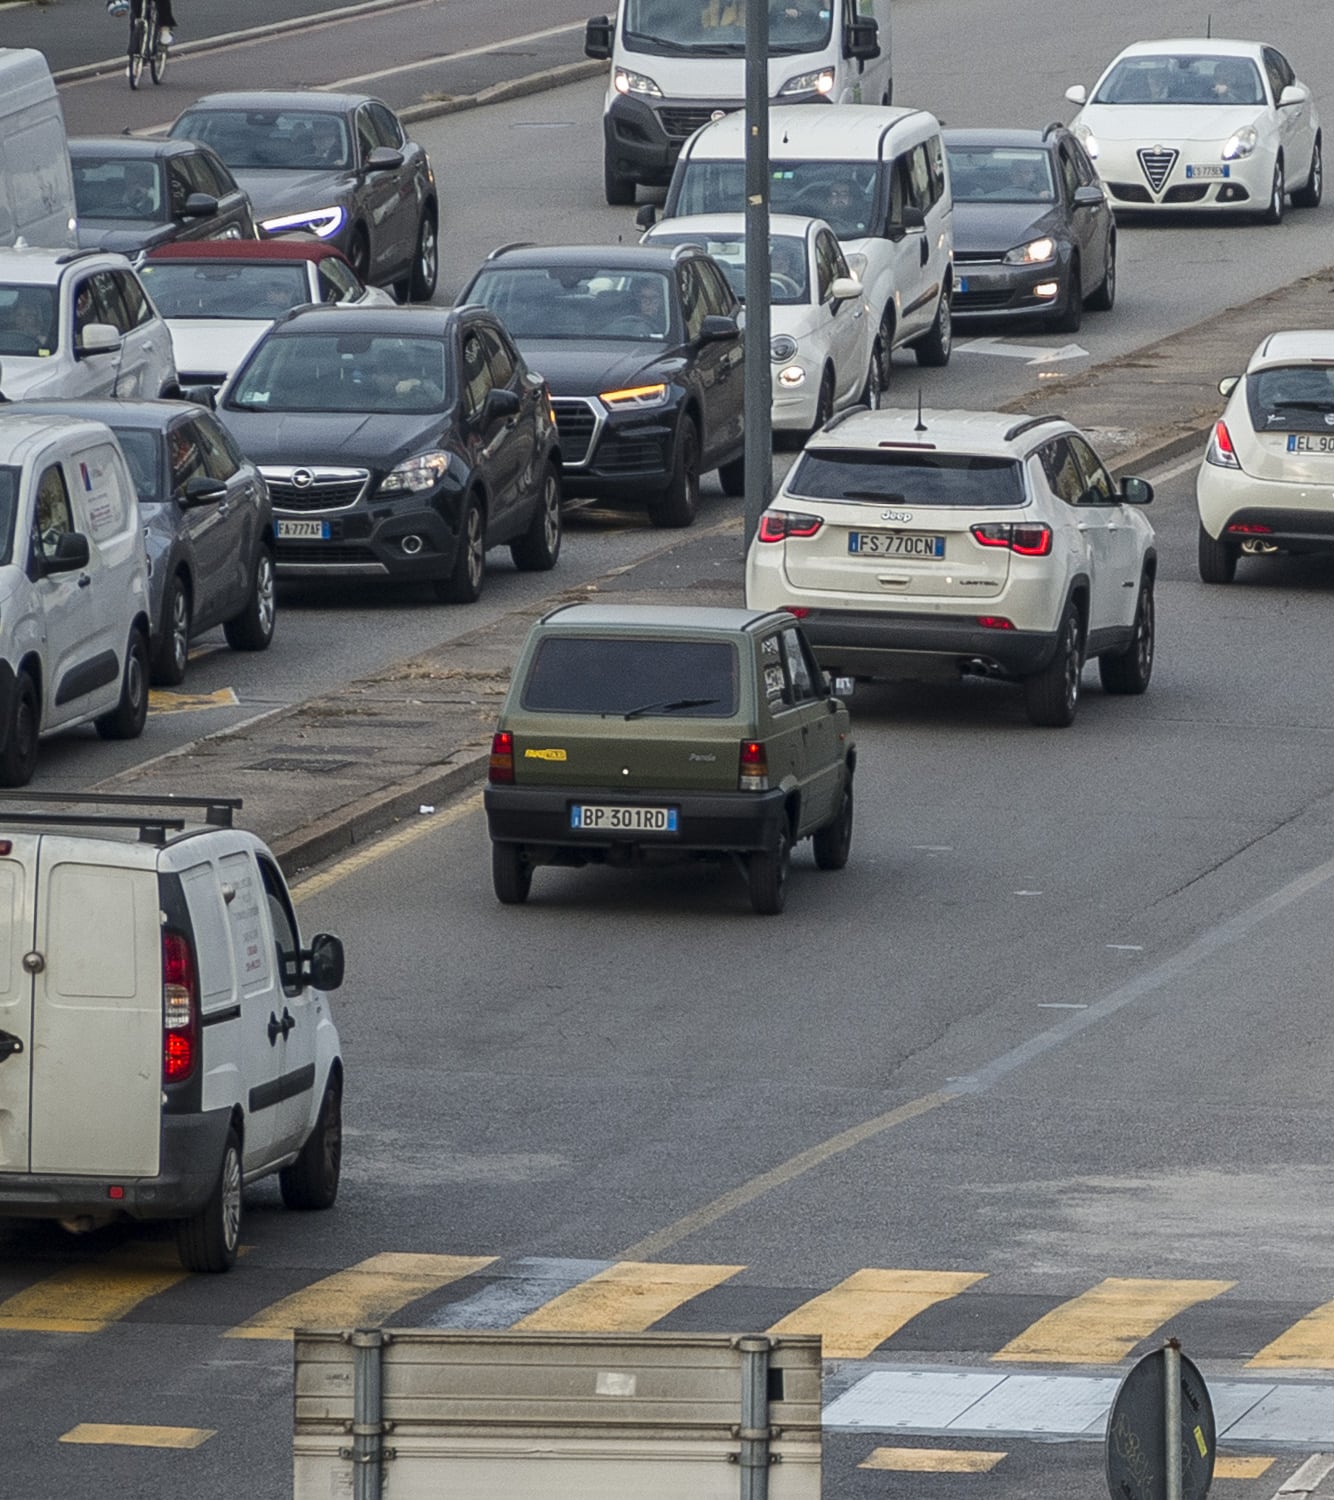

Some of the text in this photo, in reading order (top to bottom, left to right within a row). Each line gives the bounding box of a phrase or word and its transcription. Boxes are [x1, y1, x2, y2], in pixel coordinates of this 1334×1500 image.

[1297, 436, 1314, 450] EL
[881, 510, 912, 523] Jeep
[860, 535, 934, 554] FS 770CN
[583, 808, 665, 828] BP 301RD
